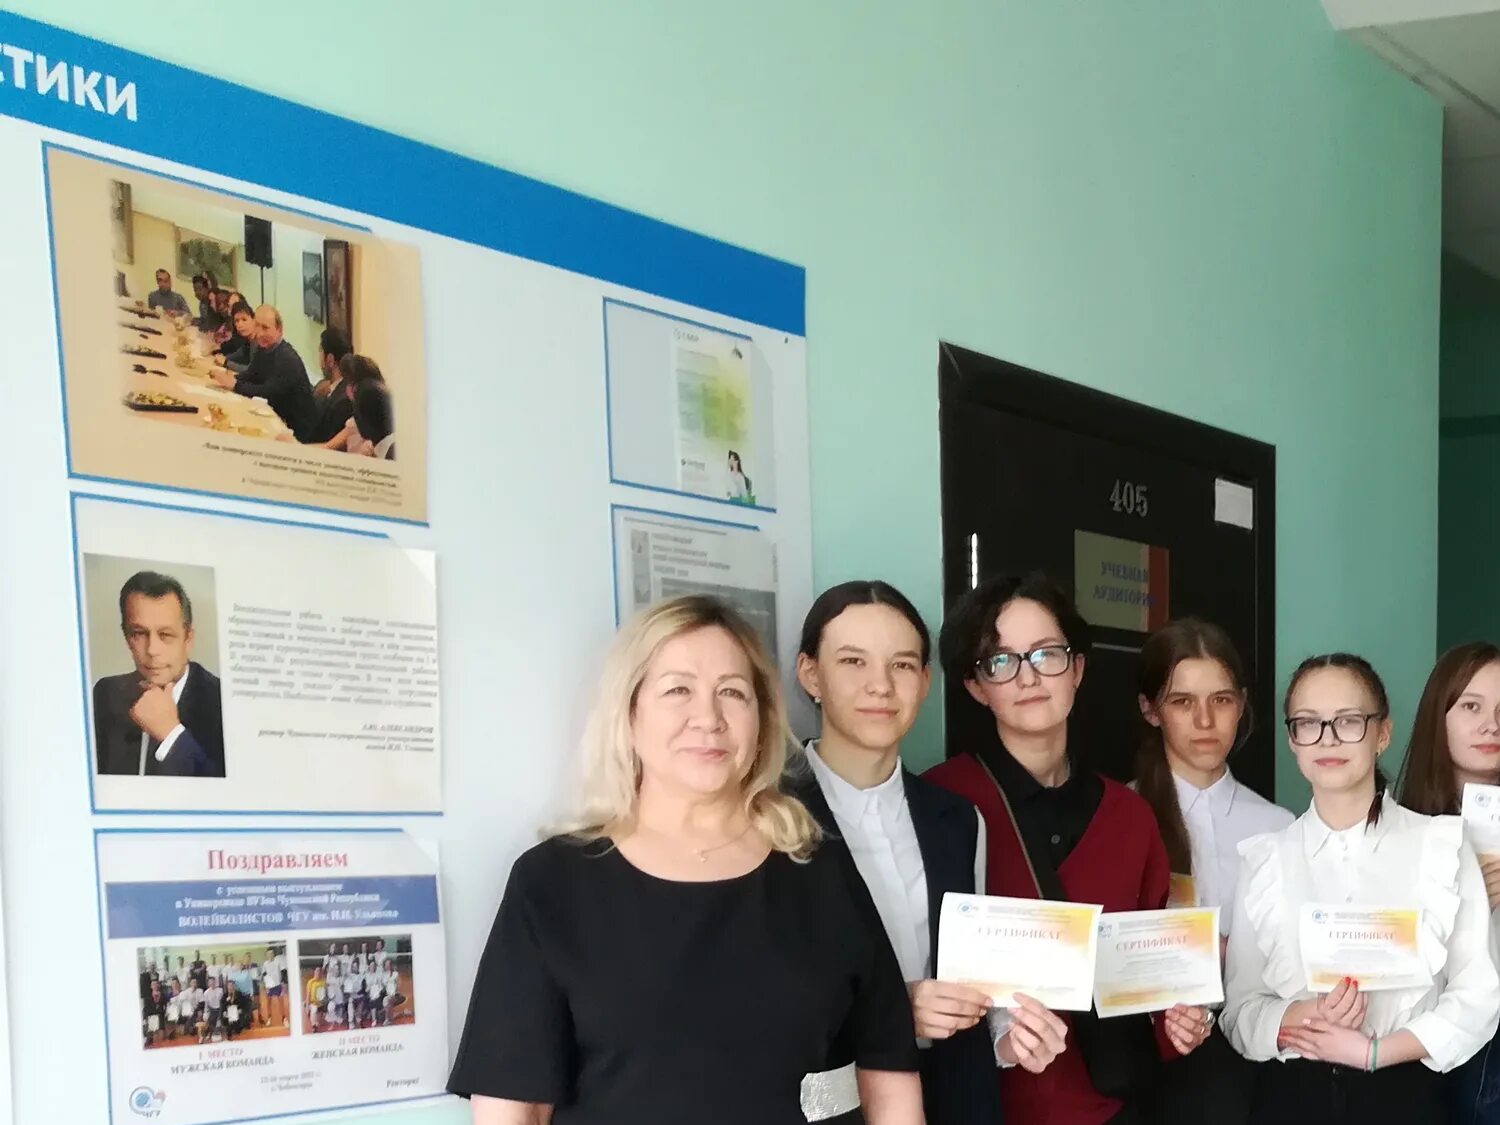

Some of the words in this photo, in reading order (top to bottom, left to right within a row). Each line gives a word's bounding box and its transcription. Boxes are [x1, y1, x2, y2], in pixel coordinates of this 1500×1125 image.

[0, 41, 138, 122] ТИКИ
[1109, 479, 1148, 518] 405
[208, 849, 349, 874] Поздравляем
[1116, 935, 1188, 952] СЕРТИФИКАТ
[312, 1047, 358, 1060] ЖЕНСКАЯ
[359, 1042, 404, 1055] КОМАНДА
[170, 1060, 223, 1075] МУЖСКАЯ
[225, 1056, 275, 1069] КОМАНДА
